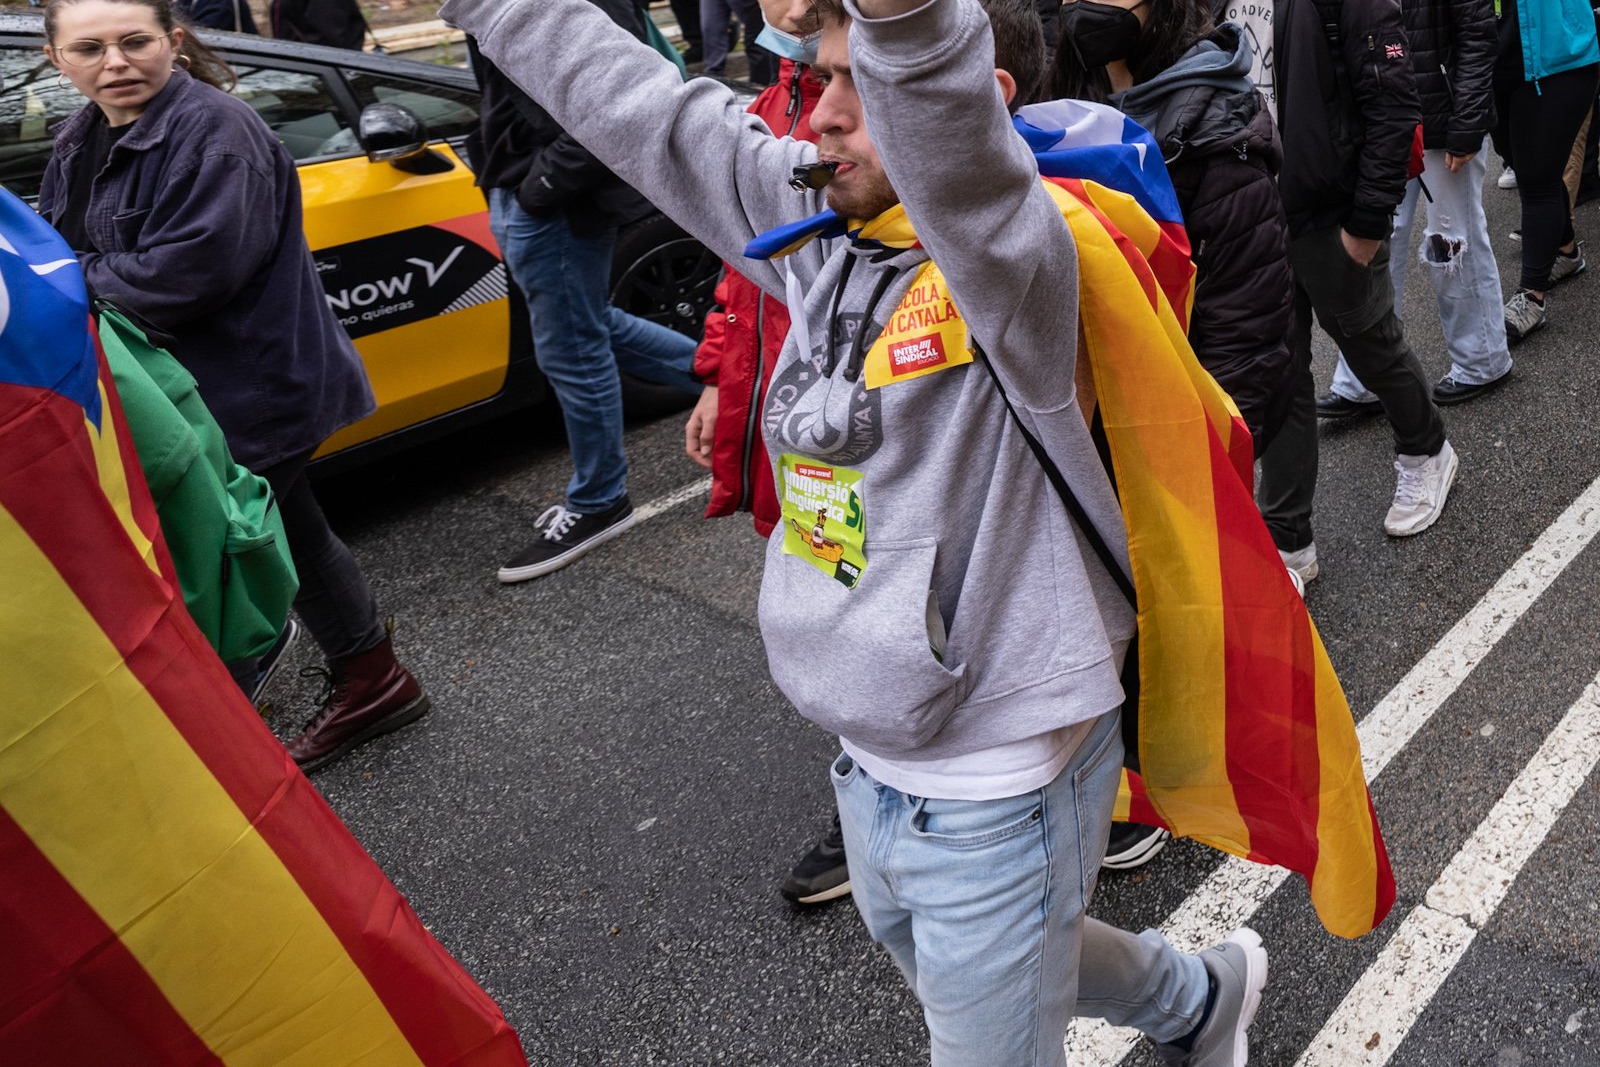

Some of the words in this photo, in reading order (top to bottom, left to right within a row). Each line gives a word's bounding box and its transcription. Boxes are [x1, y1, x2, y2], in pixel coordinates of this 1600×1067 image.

[361, 299, 415, 321] quieras
[897, 297, 959, 333] CATALÀ
[893, 344, 920, 358] INTER
[895, 348, 939, 366] SINDICAL
